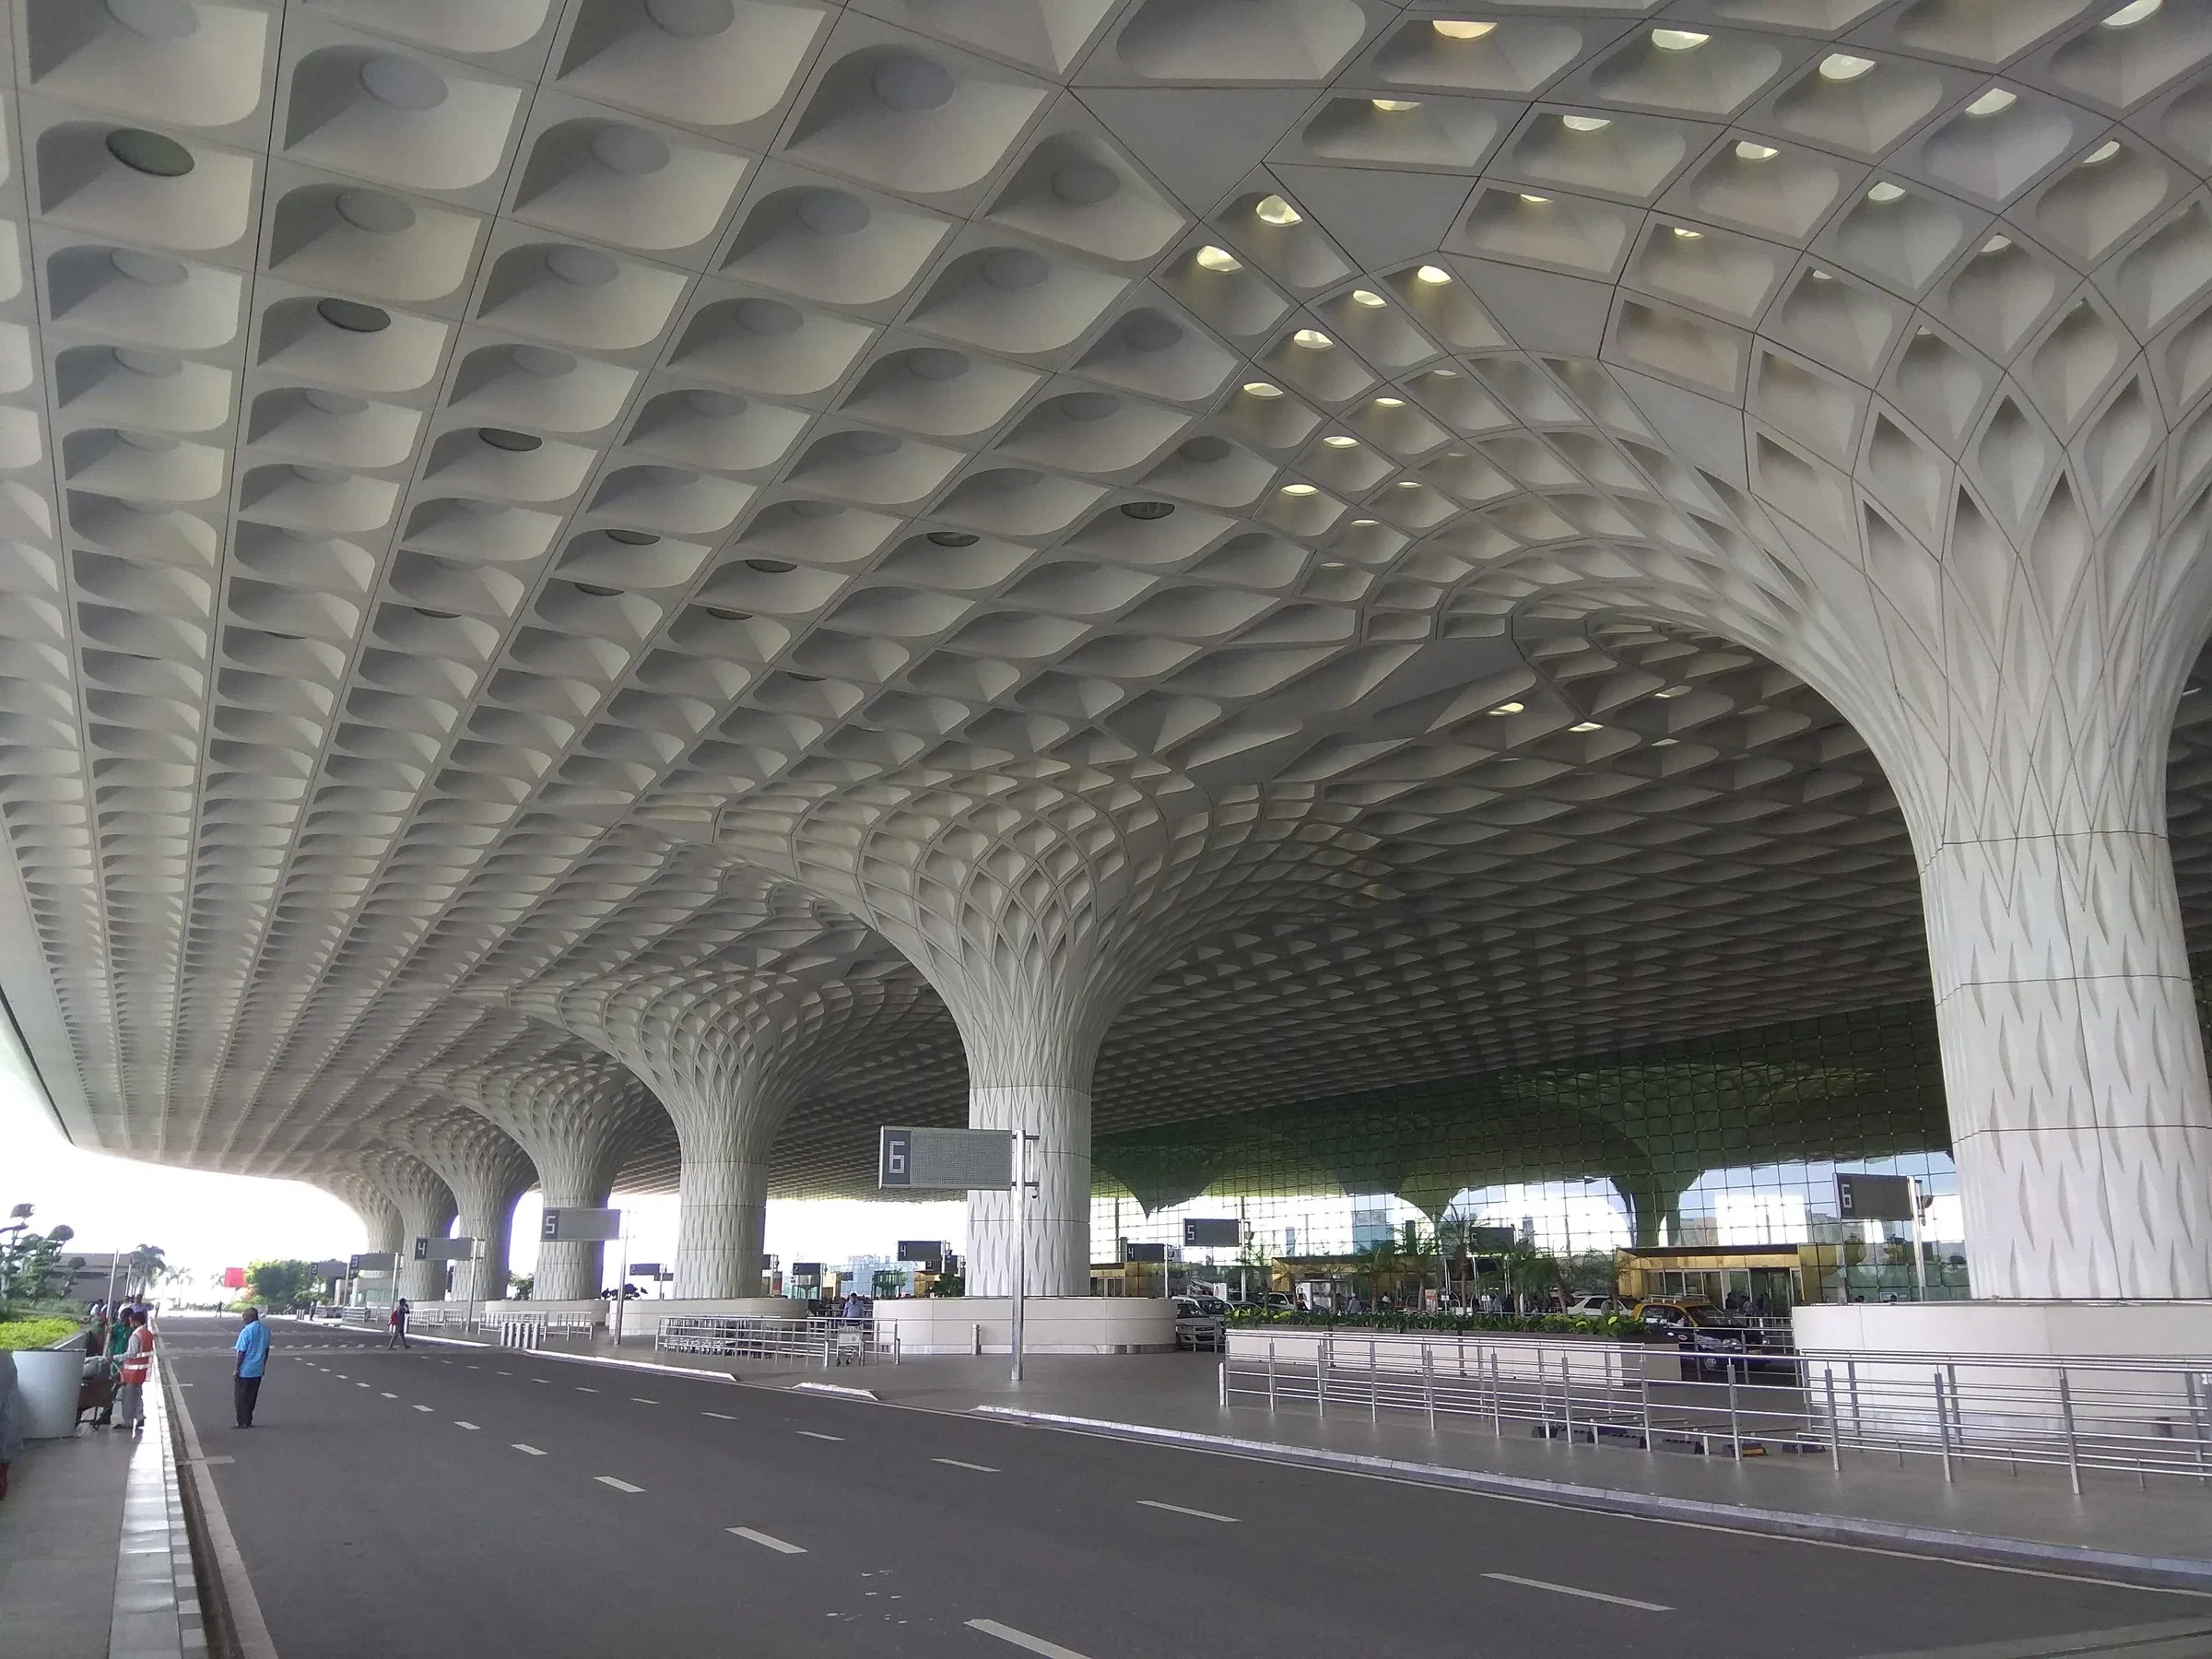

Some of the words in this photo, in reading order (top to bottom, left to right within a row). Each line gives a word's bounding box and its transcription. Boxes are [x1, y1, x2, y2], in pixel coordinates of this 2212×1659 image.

[888, 1141, 905, 1173] 6
[1841, 1183, 1853, 1208] 6
[545, 1216, 557, 1234] 5
[1187, 1225, 1195, 1241] 5
[418, 1241, 427, 1255] 4
[900, 1245, 907, 1257] 4
[1128, 1247, 1134, 1259] 4
[352, 1255, 358, 1267] 3
[312, 1264, 317, 1275] 2
